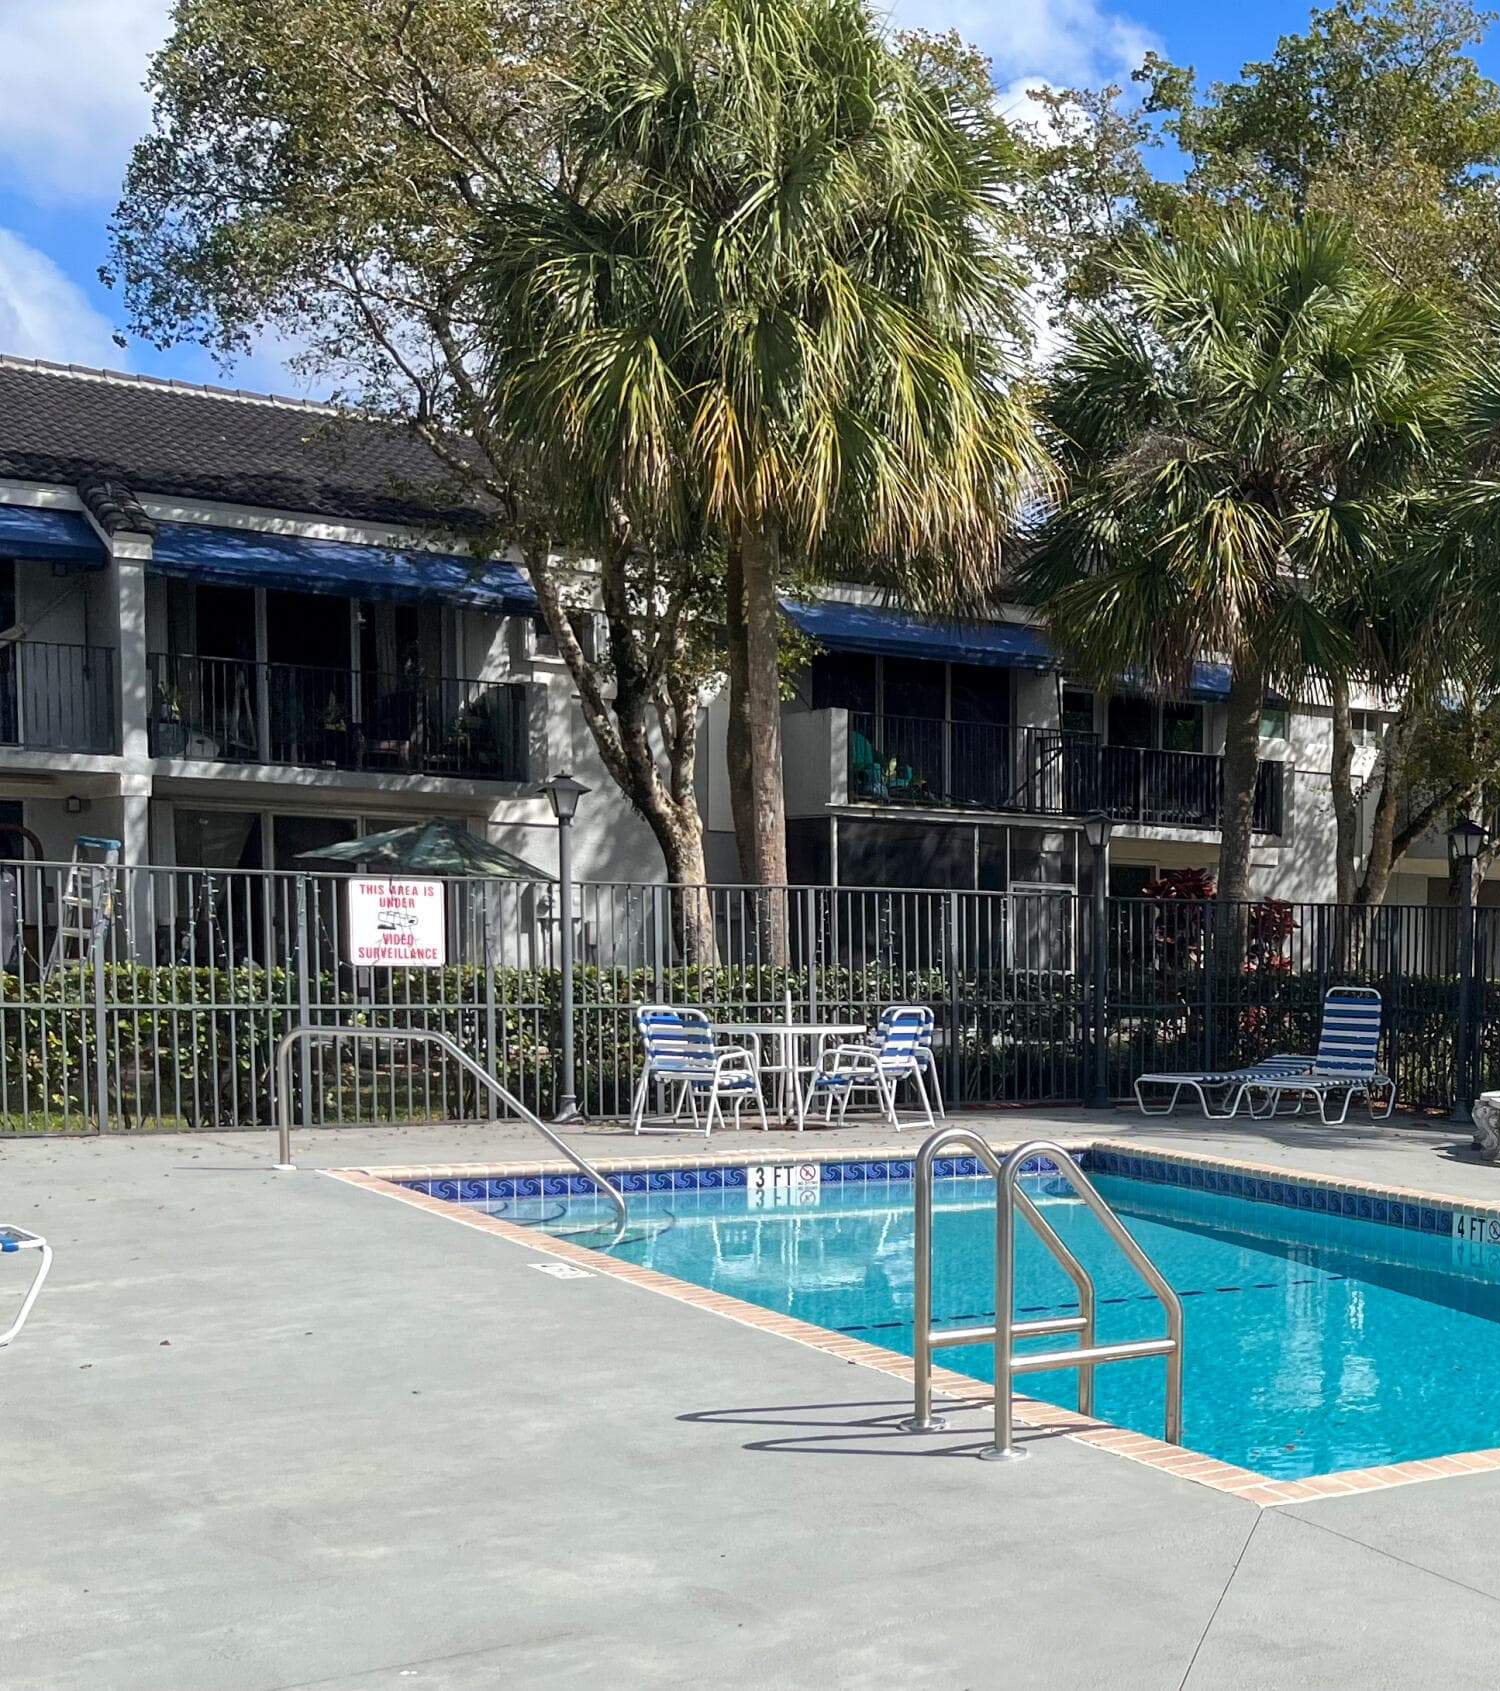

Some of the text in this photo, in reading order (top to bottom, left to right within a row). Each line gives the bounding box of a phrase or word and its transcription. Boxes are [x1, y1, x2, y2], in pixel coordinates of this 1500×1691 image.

[360, 884, 434, 896] THIS AREA IS
[379, 897, 415, 908] UNDER
[383, 933, 414, 946] VIDEO
[359, 947, 437, 960] SURVEILLANCE
[756, 1166, 795, 1188] 3 FT
[1457, 1215, 1486, 1242] 4 FT
